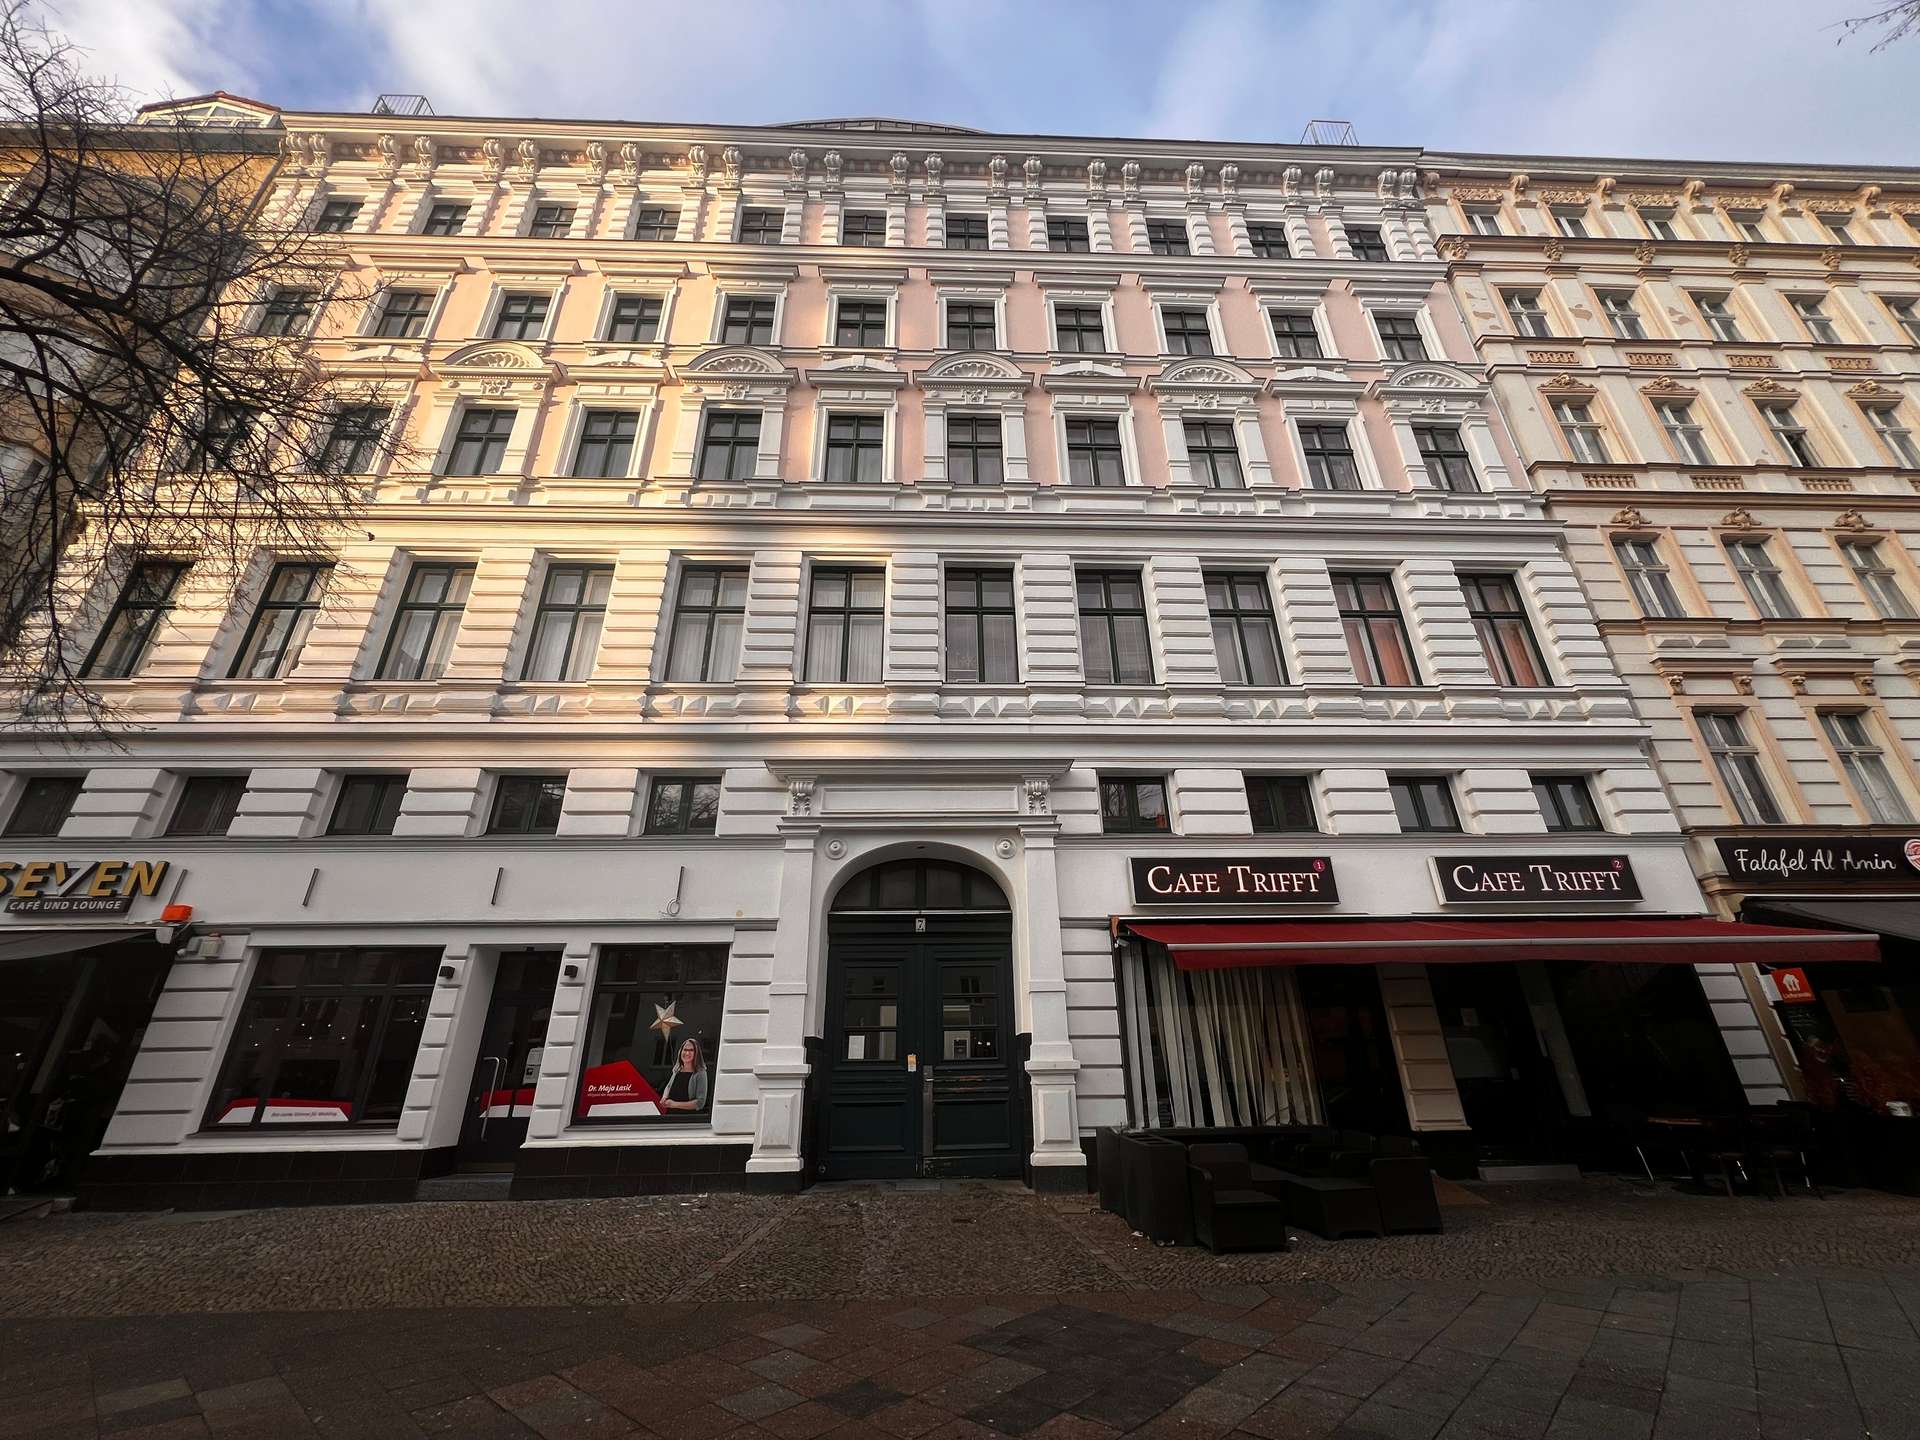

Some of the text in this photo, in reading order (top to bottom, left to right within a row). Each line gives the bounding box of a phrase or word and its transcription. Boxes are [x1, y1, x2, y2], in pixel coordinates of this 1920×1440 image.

[1734, 848, 1896, 877] Falafel Al Amin
[1147, 865, 1319, 893] CAFE TRIFFT
[1452, 864, 1621, 892] CAFE TRIFFT
[9, 900, 122, 910] CAFÉ UND LOUNGE
[588, 1084, 597, 1092] Dr.
[598, 1084, 615, 1093] Maja
